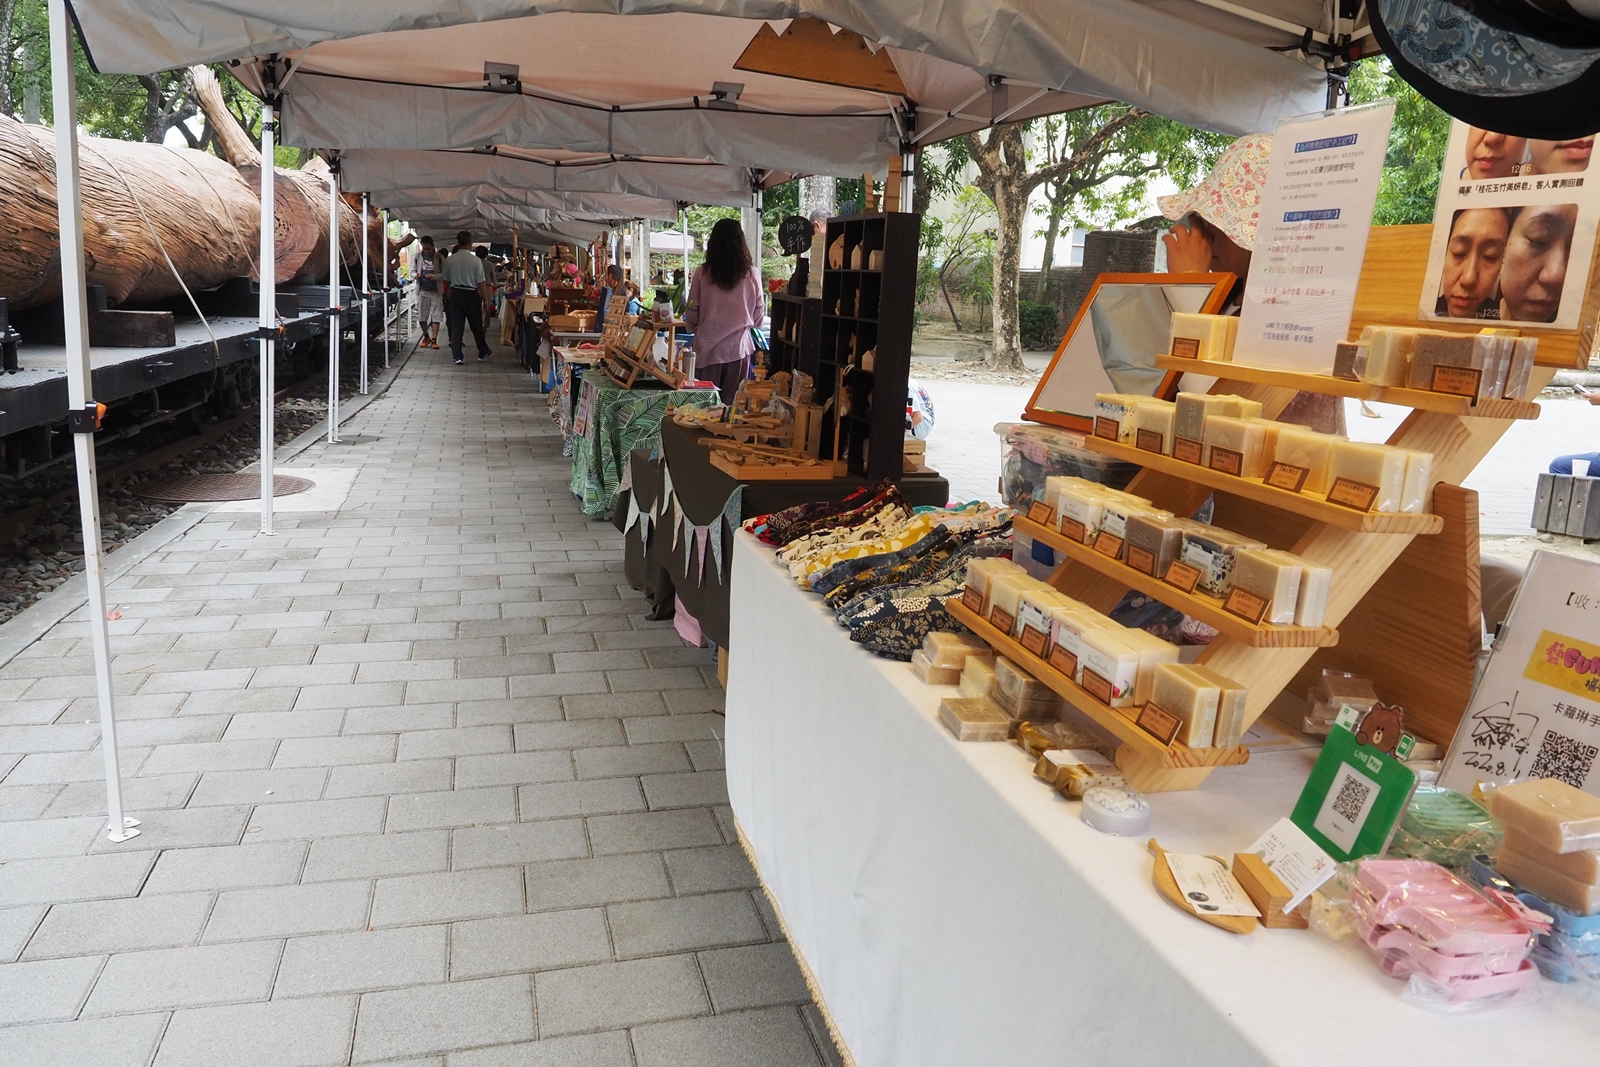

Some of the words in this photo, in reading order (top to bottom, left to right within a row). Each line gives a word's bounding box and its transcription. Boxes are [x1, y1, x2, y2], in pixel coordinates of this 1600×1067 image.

[1511, 164, 1532, 174] 12/16
[786, 219, 805, 233] 100%
[787, 234, 806, 252] 手作
[1354, 749, 1369, 763] LINE
